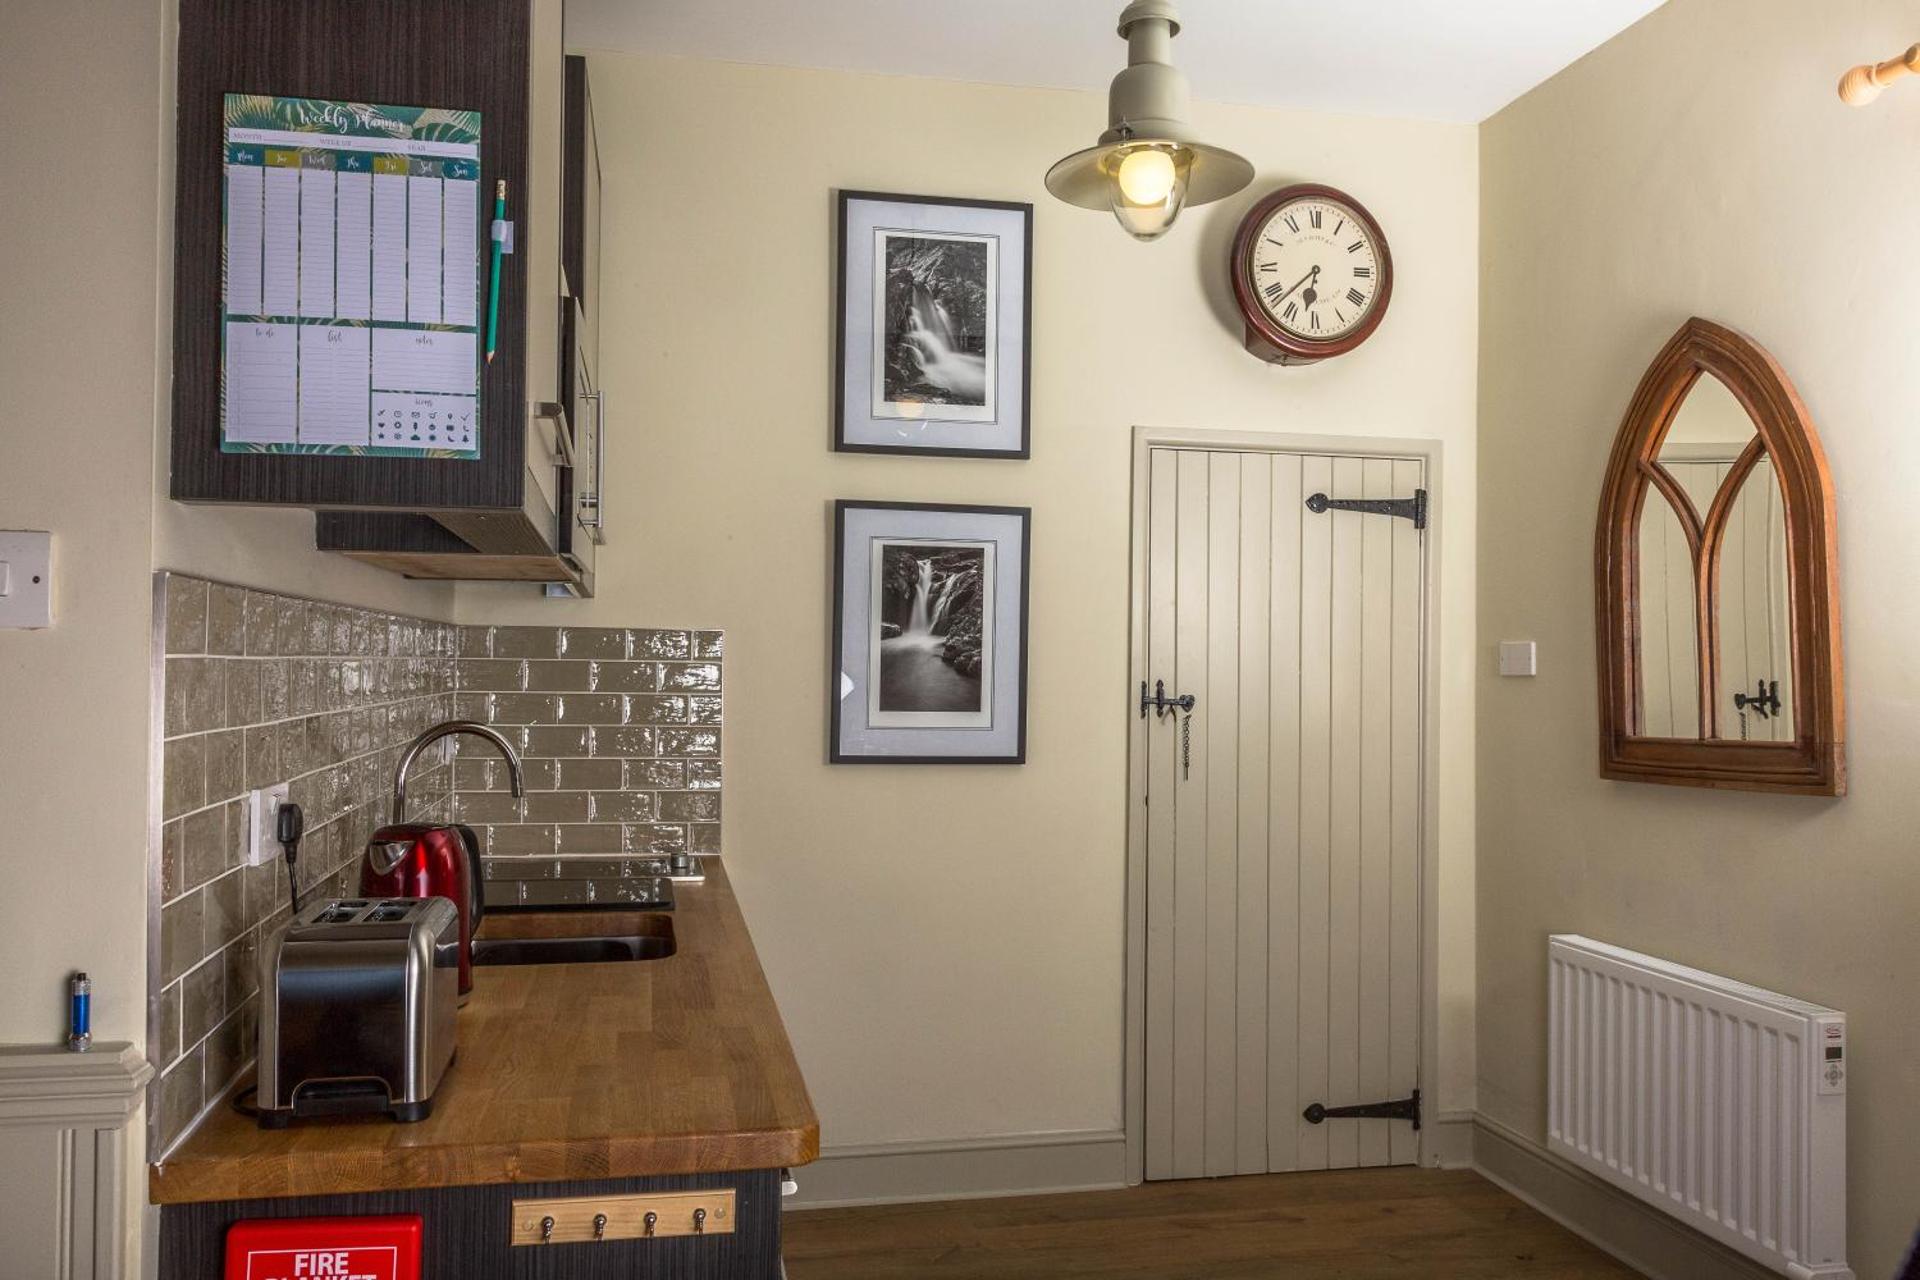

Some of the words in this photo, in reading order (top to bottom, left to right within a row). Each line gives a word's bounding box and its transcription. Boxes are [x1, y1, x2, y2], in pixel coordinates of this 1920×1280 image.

[300, 106, 348, 133] Weekly
[1347, 241, 1364, 253] II
[1353, 267, 1370, 278] III
[294, 1252, 349, 1276] FIRE
